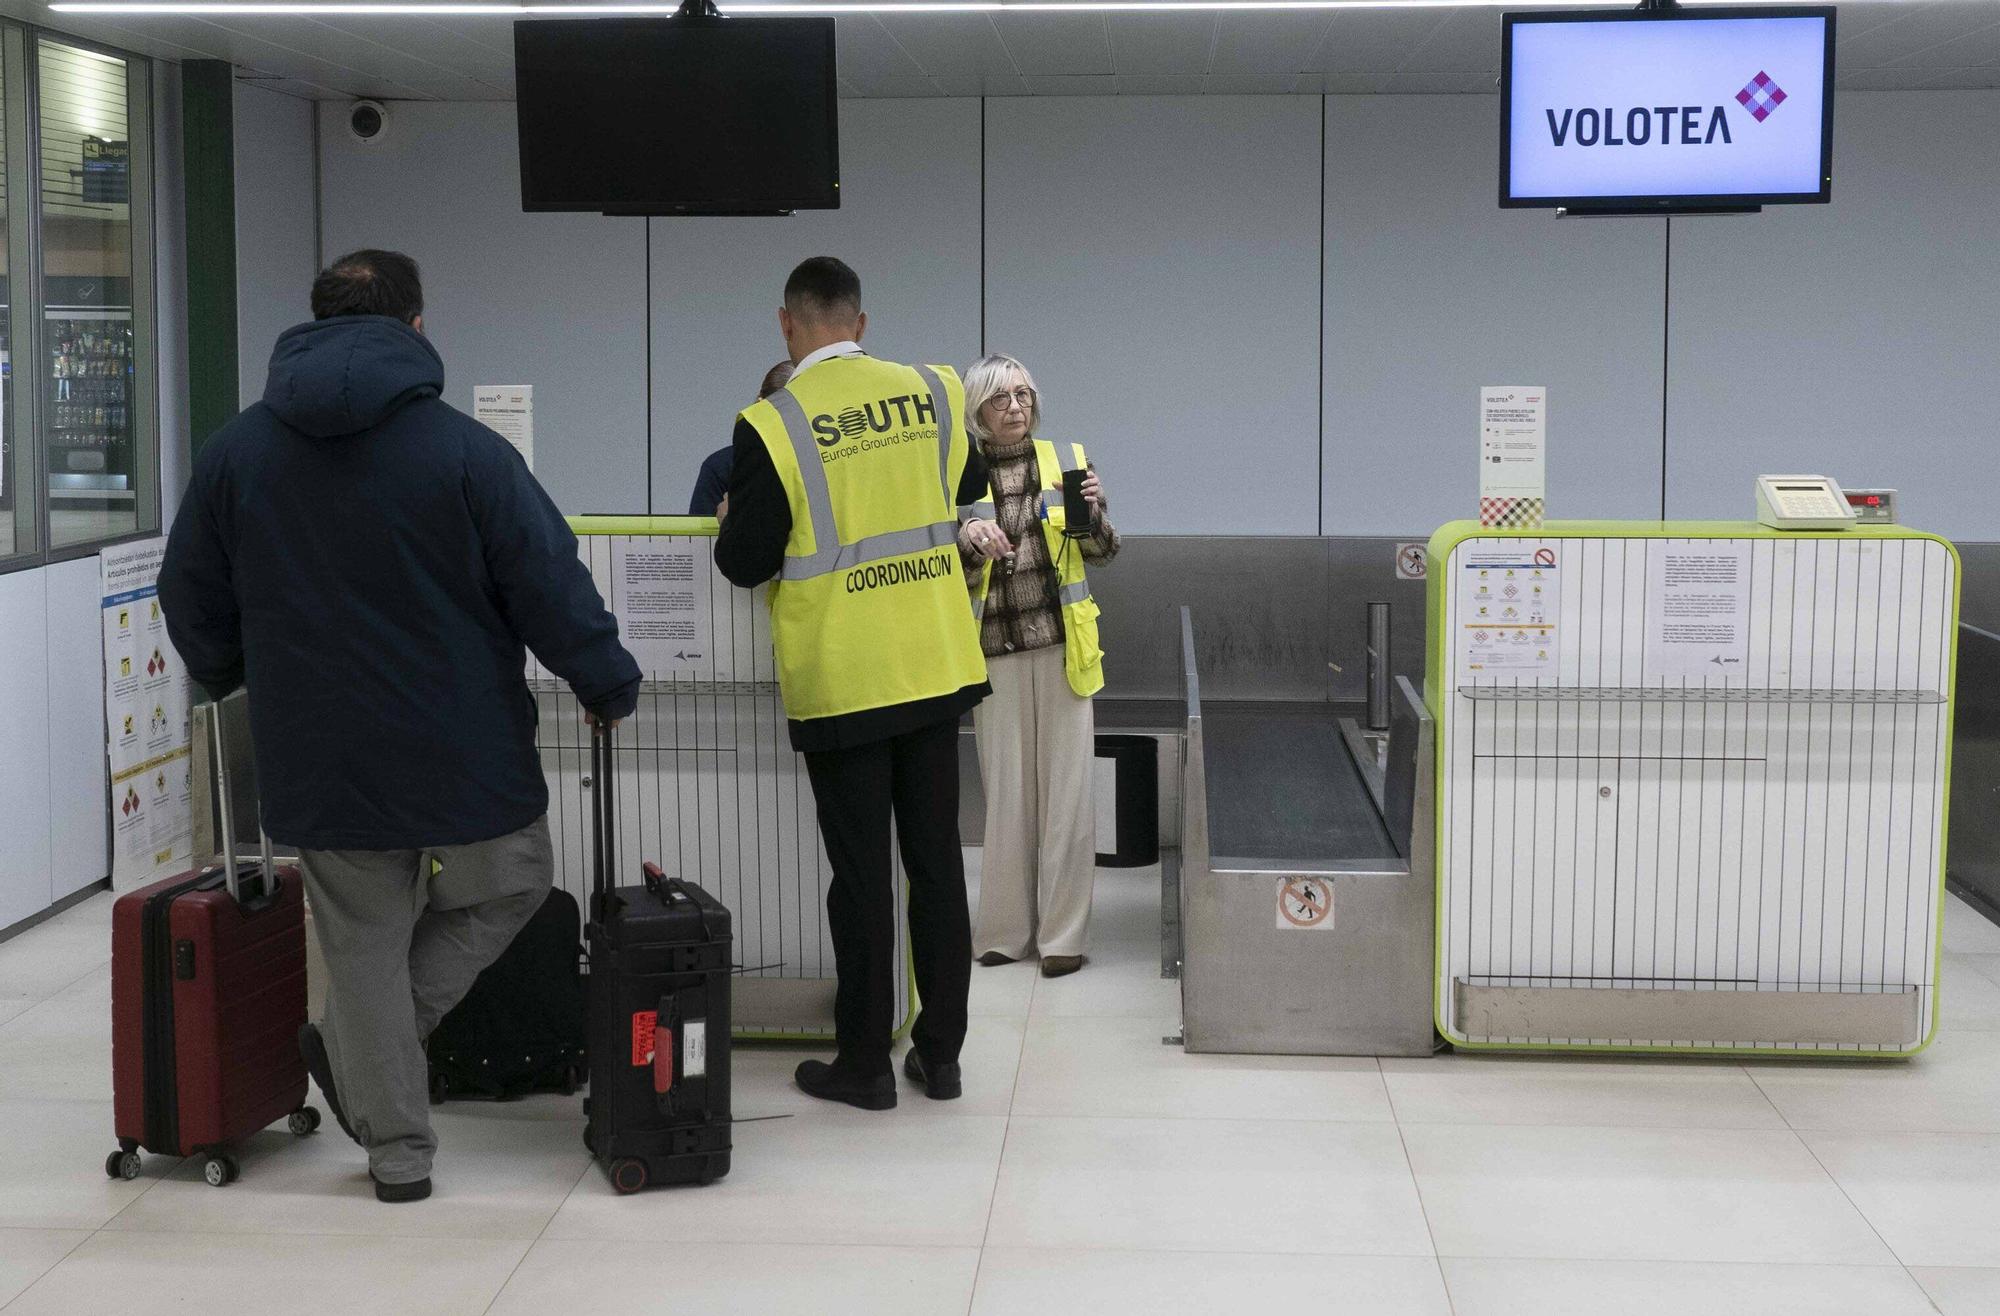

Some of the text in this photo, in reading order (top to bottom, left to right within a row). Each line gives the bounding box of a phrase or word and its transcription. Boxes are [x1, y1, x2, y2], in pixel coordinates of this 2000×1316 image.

[1546, 106, 1732, 147] VOLOTEA
[811, 393, 937, 447] SOUTH
[821, 427, 939, 464] Europe Ground Services
